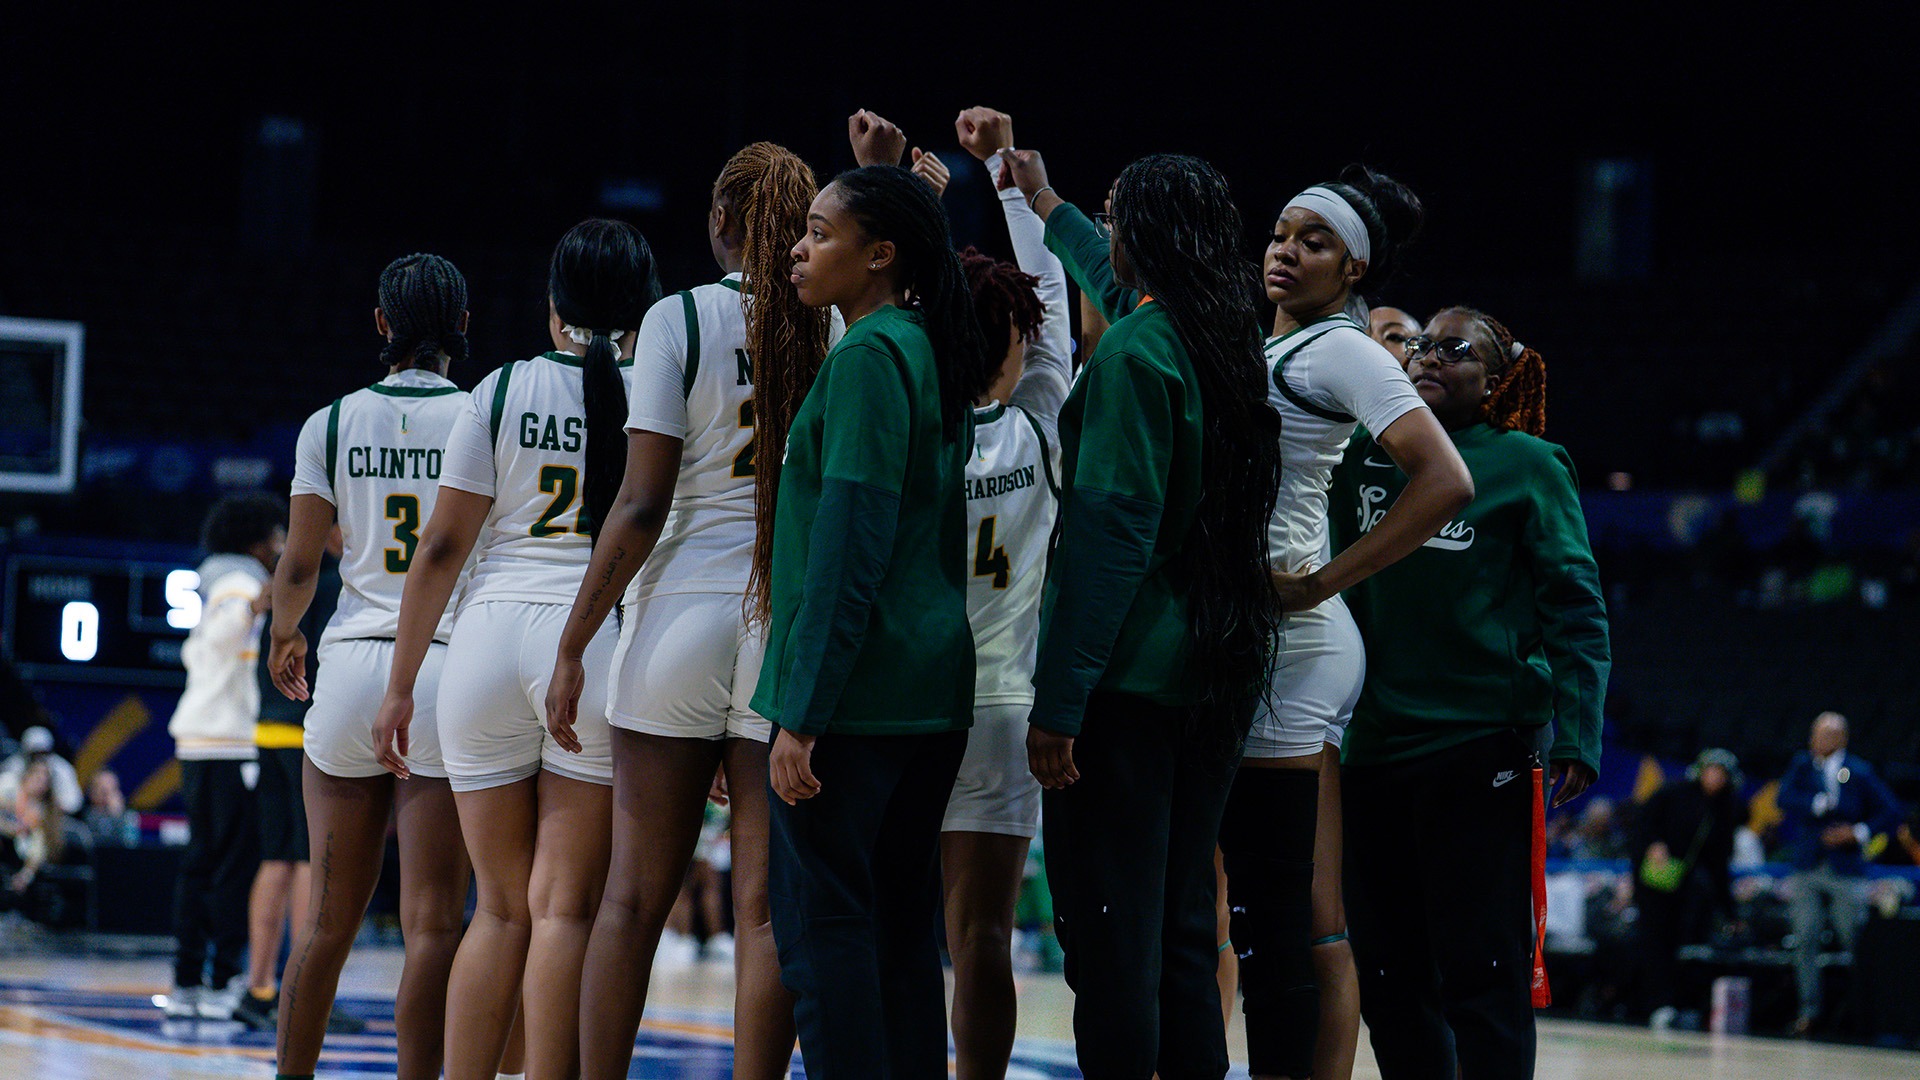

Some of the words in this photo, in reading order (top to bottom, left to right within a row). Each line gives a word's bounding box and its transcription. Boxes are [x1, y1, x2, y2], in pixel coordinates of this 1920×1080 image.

[519, 412, 588, 452] GAS
[348, 447, 445, 479] CLINTO
[965, 464, 1035, 500] HARDSON
[528, 463, 592, 537] 2
[384, 493, 421, 574] 3
[973, 514, 1011, 590] 4
[61, 601, 99, 661] 0
[1496, 770, 1514, 781] NIKE
